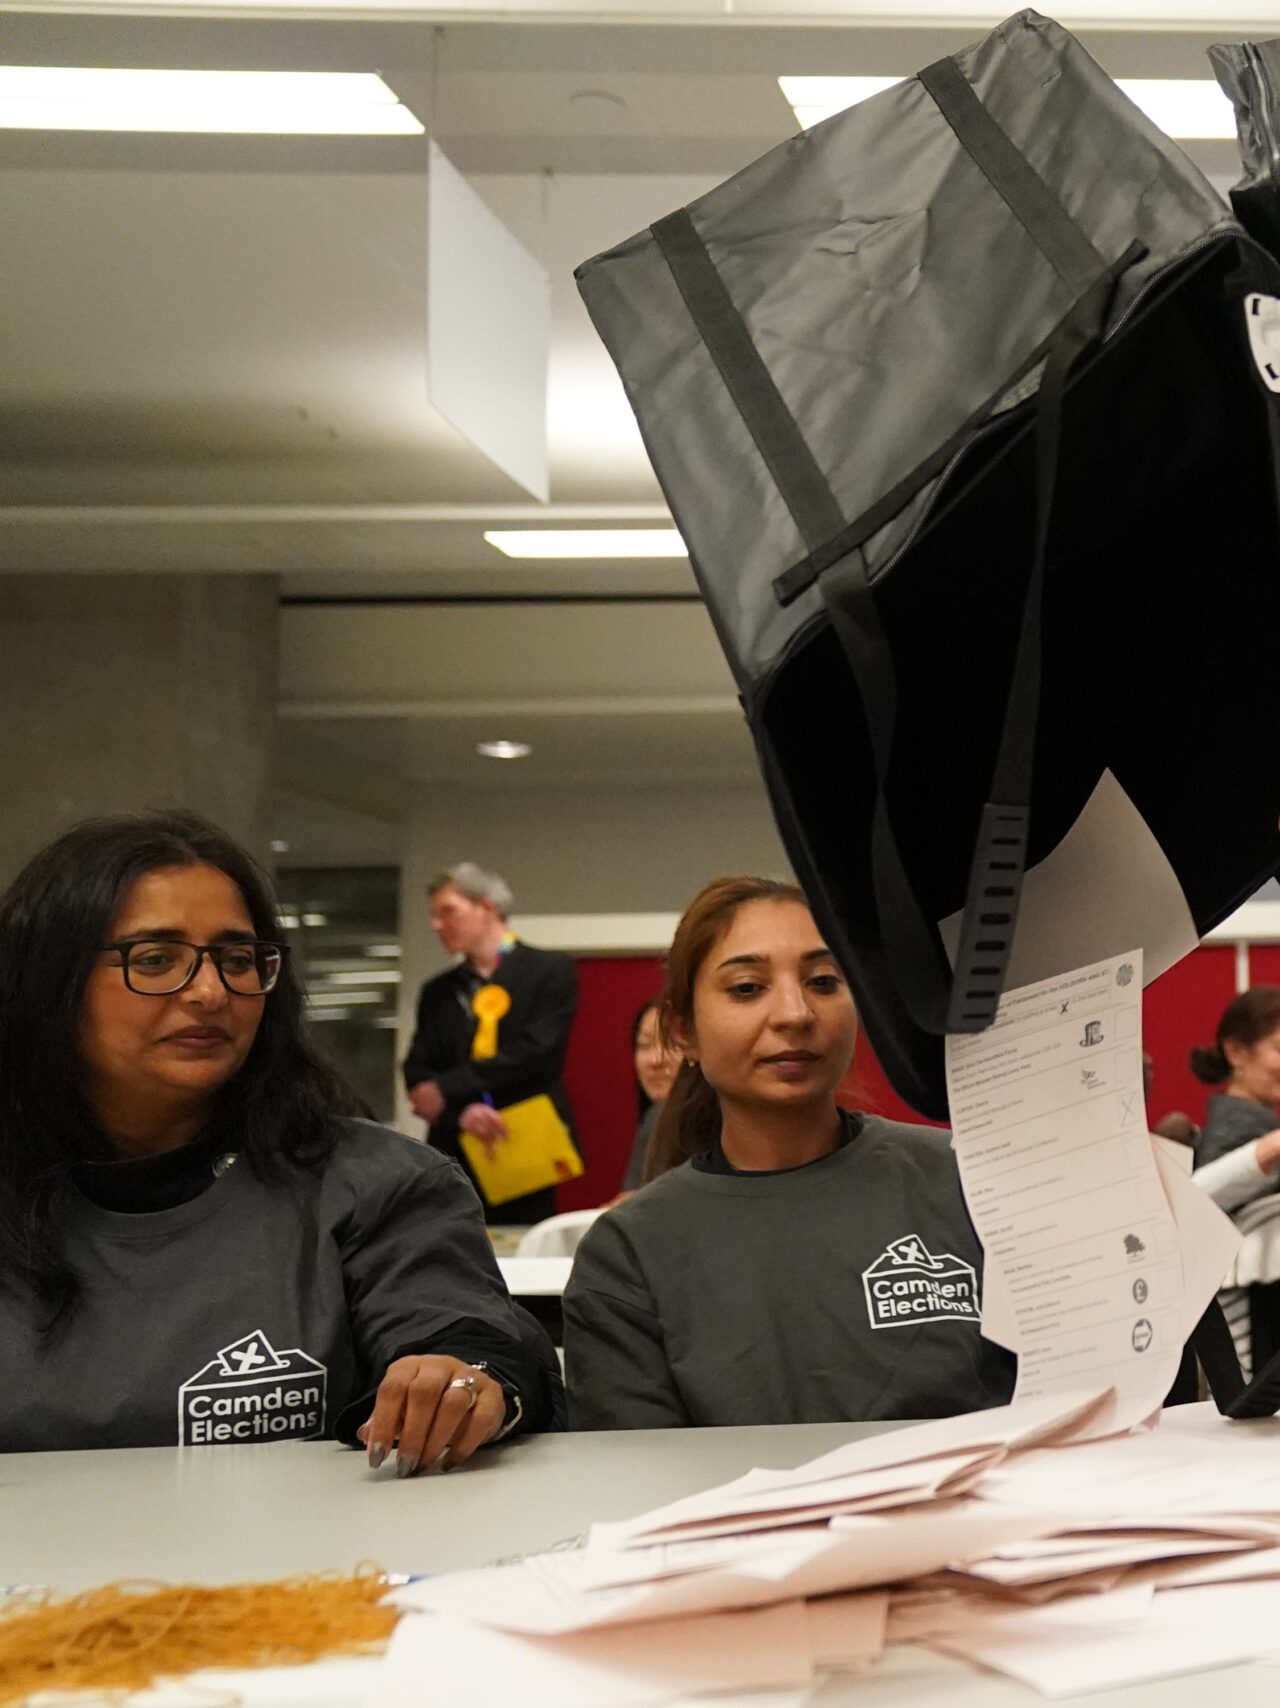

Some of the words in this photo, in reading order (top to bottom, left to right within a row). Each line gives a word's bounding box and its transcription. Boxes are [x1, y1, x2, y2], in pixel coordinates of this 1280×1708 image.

[873, 1280, 970, 1299] Camden
[877, 1293, 973, 1319] Elections
[188, 1386, 319, 1419] Camden
[191, 1411, 318, 1444] Elections
